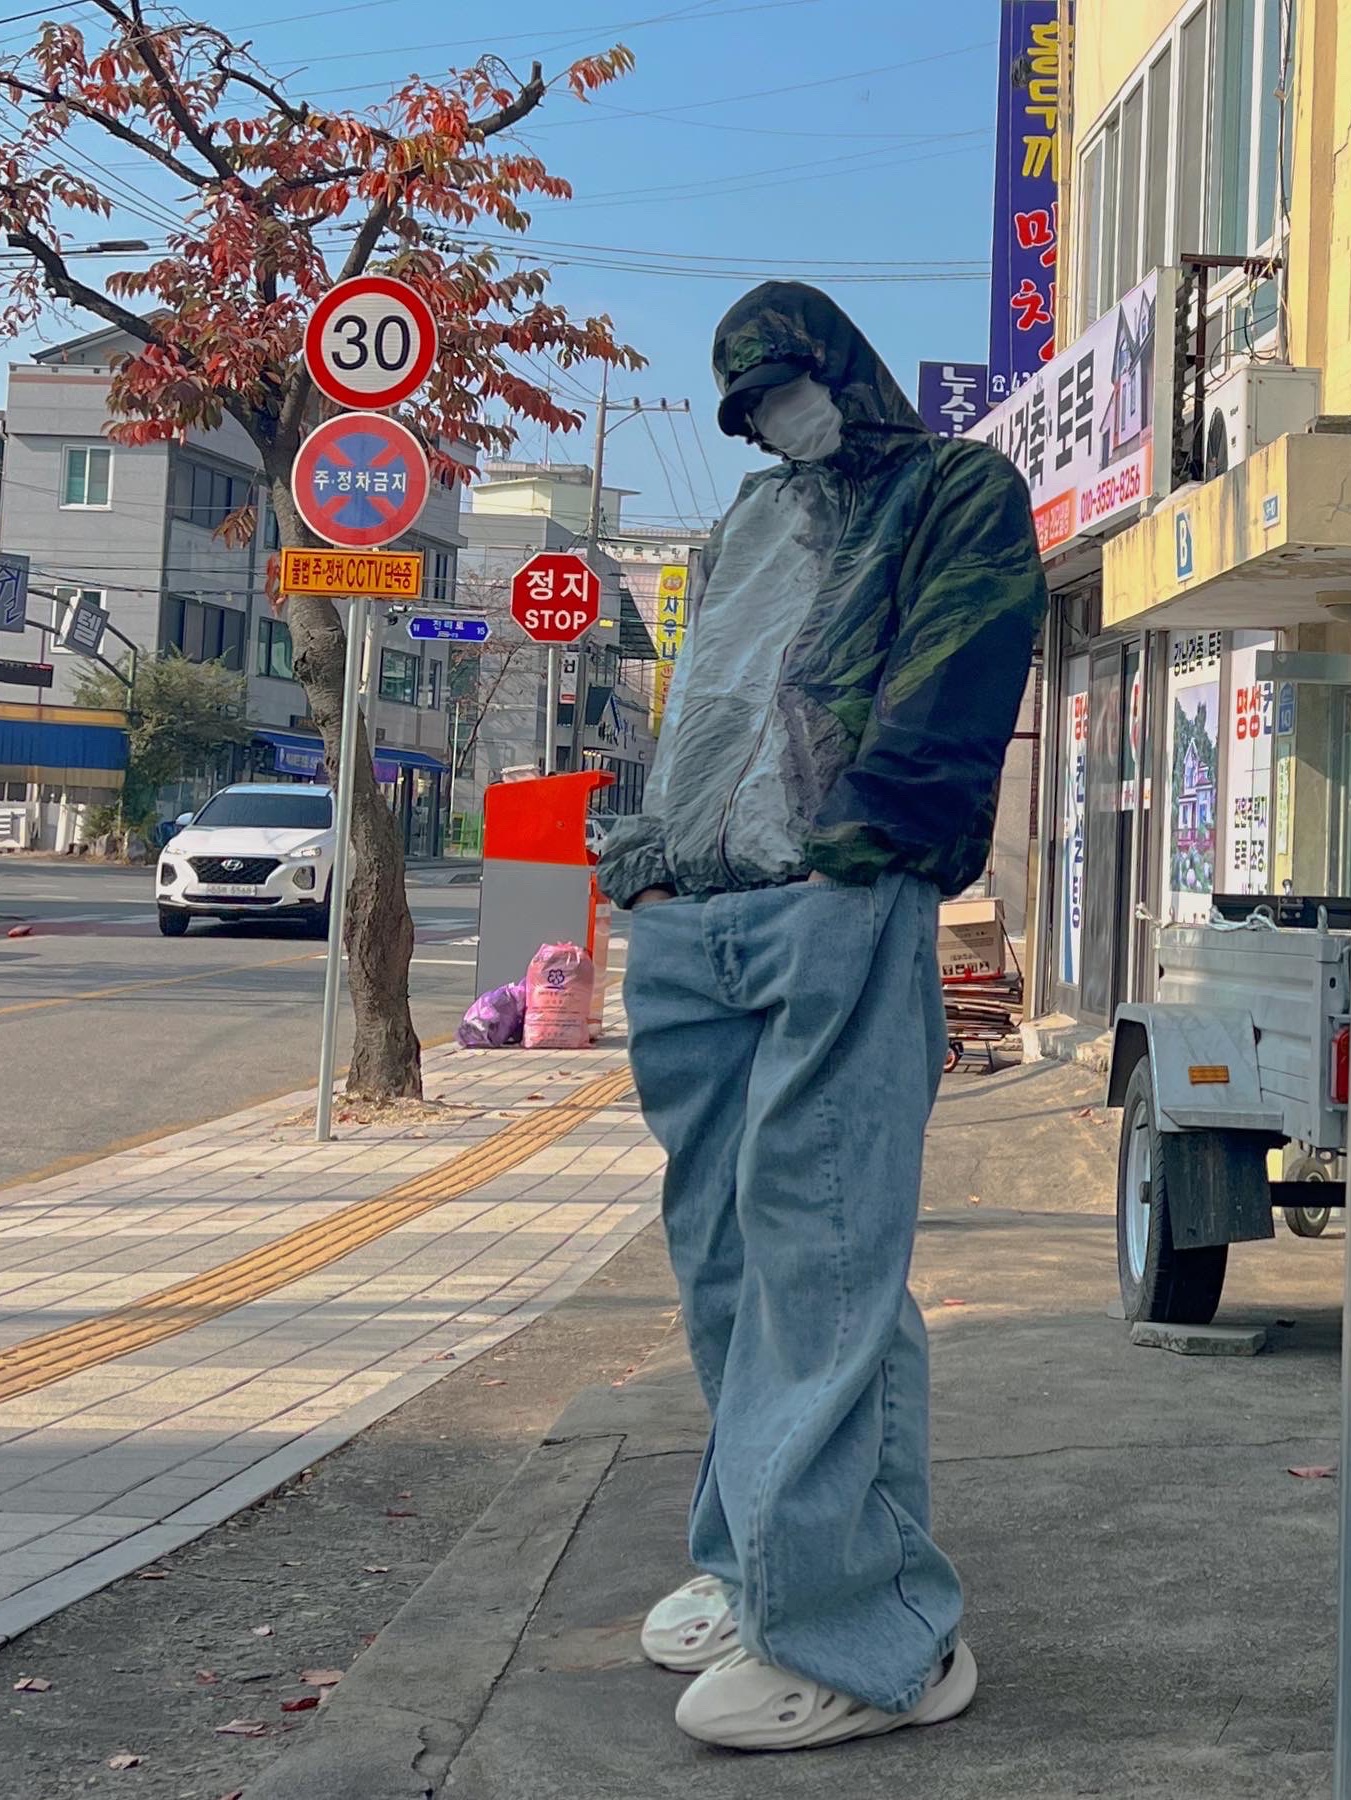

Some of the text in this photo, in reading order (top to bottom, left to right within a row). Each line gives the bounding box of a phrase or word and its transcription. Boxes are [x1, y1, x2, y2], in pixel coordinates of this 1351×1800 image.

[331, 315, 411, 371] 30
[940, 366, 977, 438] 누수
[1055, 348, 1095, 471] 토목
[292, 557, 310, 586] 불법
[346, 558, 383, 588] CCTV
[385, 560, 412, 590] 단속중
[526, 568, 589, 602] 정지
[524, 608, 587, 630] STOP
[660, 595, 680, 660] 사우나
